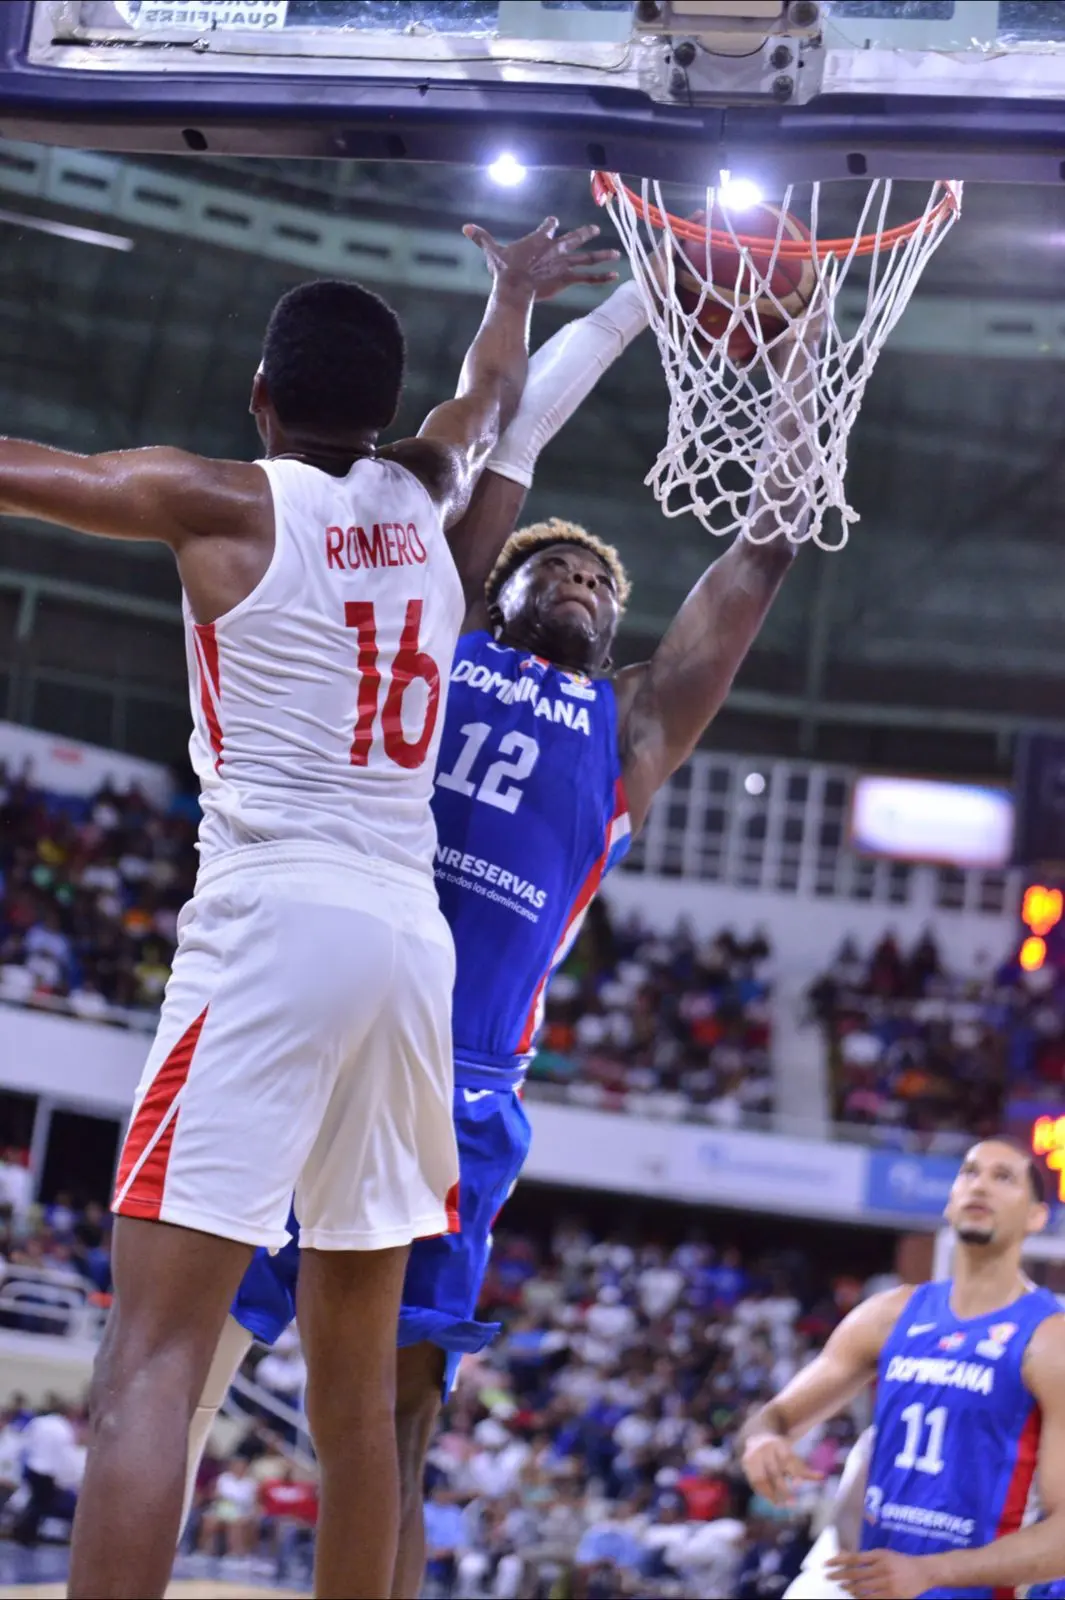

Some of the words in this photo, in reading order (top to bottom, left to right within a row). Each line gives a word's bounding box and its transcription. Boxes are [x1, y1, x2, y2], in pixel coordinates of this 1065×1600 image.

[325, 522, 427, 570] ROMERO
[344, 598, 440, 769] 16
[436, 722, 539, 814] 12
[435, 843, 547, 909] NRESERVAS
[447, 873, 473, 890] todos
[473, 882, 487, 896] los
[487, 889, 540, 924] dominicanos
[894, 1402, 948, 1476] 11
